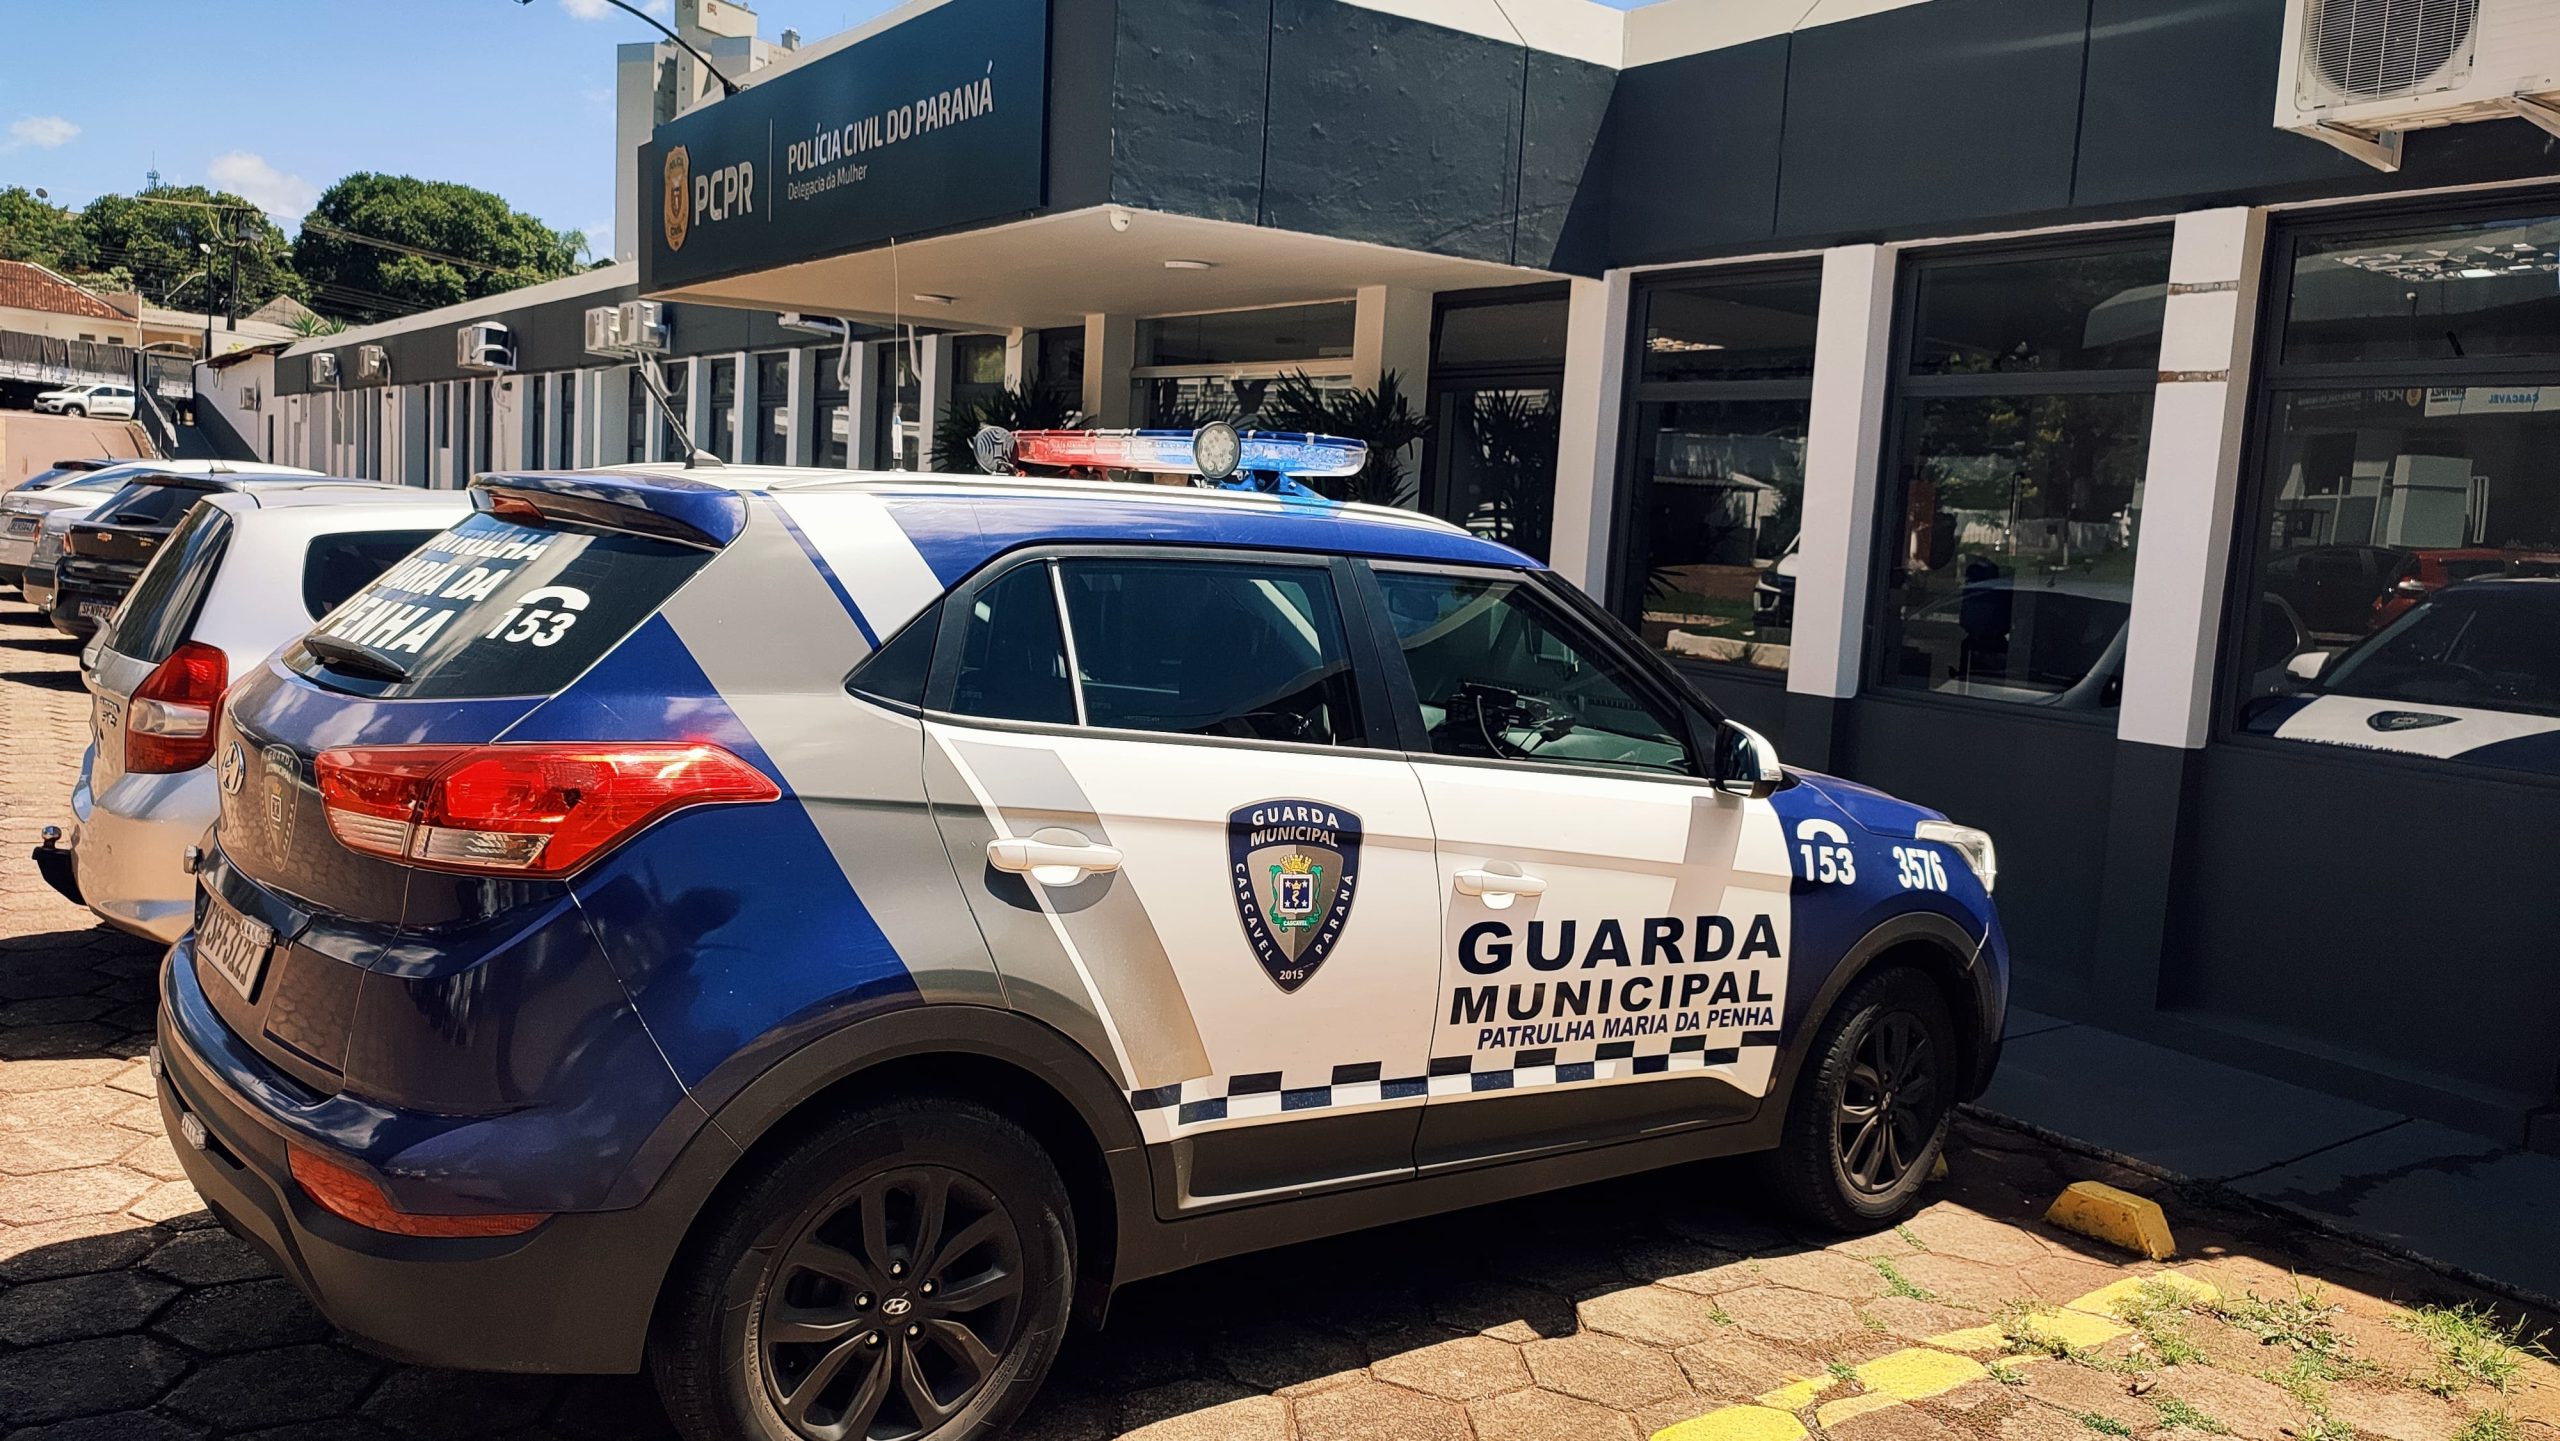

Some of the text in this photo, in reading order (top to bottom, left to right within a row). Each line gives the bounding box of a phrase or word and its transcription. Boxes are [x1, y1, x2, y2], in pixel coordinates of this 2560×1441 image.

[788, 60, 994, 175] POLÍCIA CIVIL DO PARANÁ
[695, 161, 753, 226] PCPR
[788, 163, 868, 201] Delegacia da Mulher
[439, 567, 512, 602] DA
[486, 607, 576, 647] 153
[1250, 826, 1339, 848] MUNICIPAL
[1252, 806, 1340, 829] GUARDA
[1800, 844, 1856, 886] 153
[1892, 846, 1948, 892] 3576
[1236, 863, 1274, 961] CASCAVEL
[1315, 875, 1354, 955] PARANÁ
[1457, 914, 1782, 975] GUARDA
[1279, 970, 1304, 980] 2015
[1449, 970, 1774, 1025] MUNICIPAL
[1477, 1006, 1774, 1050] PATRULHA MARIA DA PENHA
